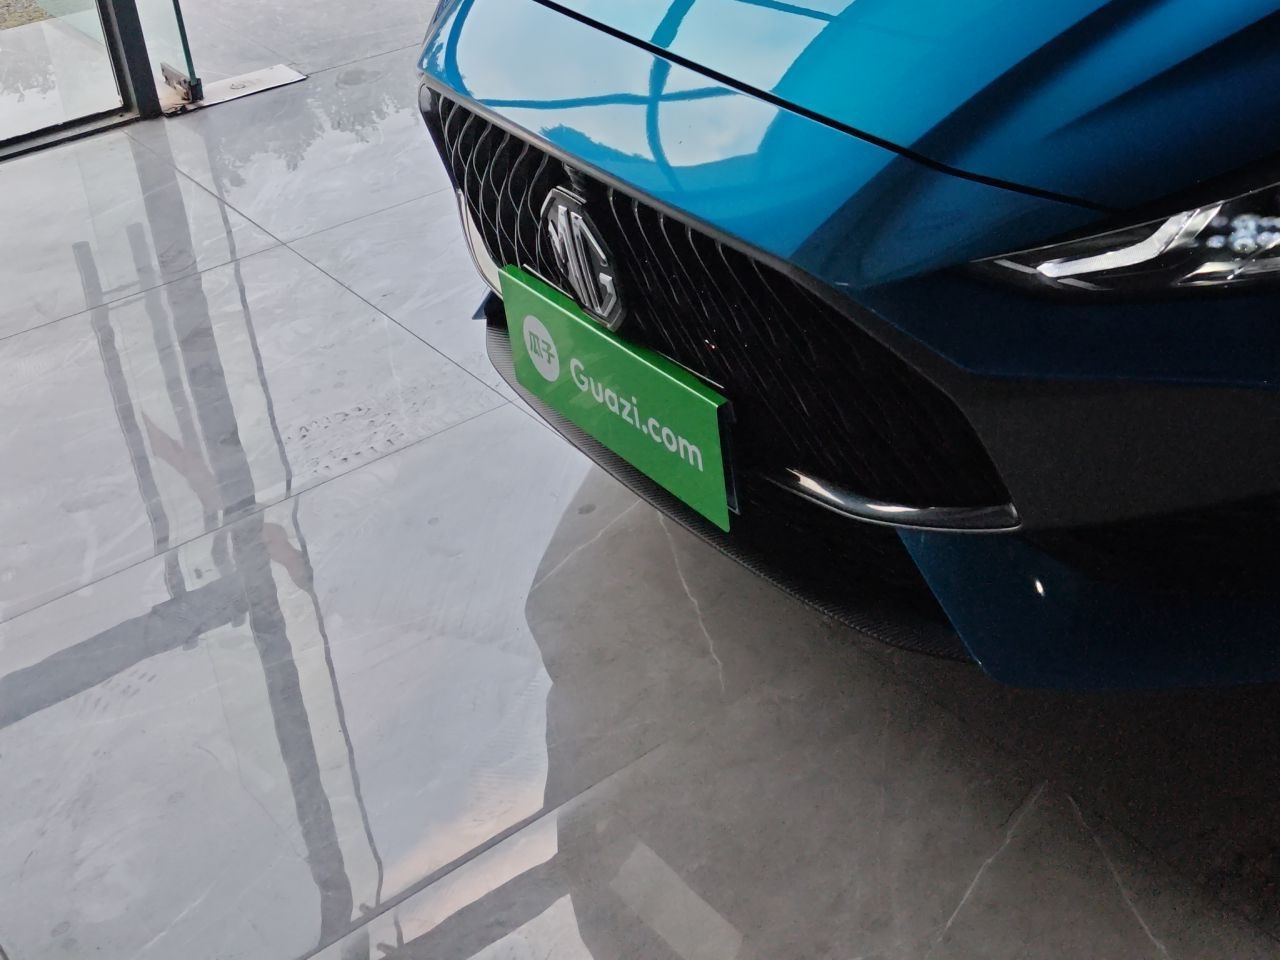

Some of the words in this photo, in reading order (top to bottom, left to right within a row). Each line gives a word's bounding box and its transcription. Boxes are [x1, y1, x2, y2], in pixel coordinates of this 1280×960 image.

[548, 204, 617, 318] MG
[528, 330, 556, 365] 瓜子
[569, 357, 704, 472] Guazi.com
